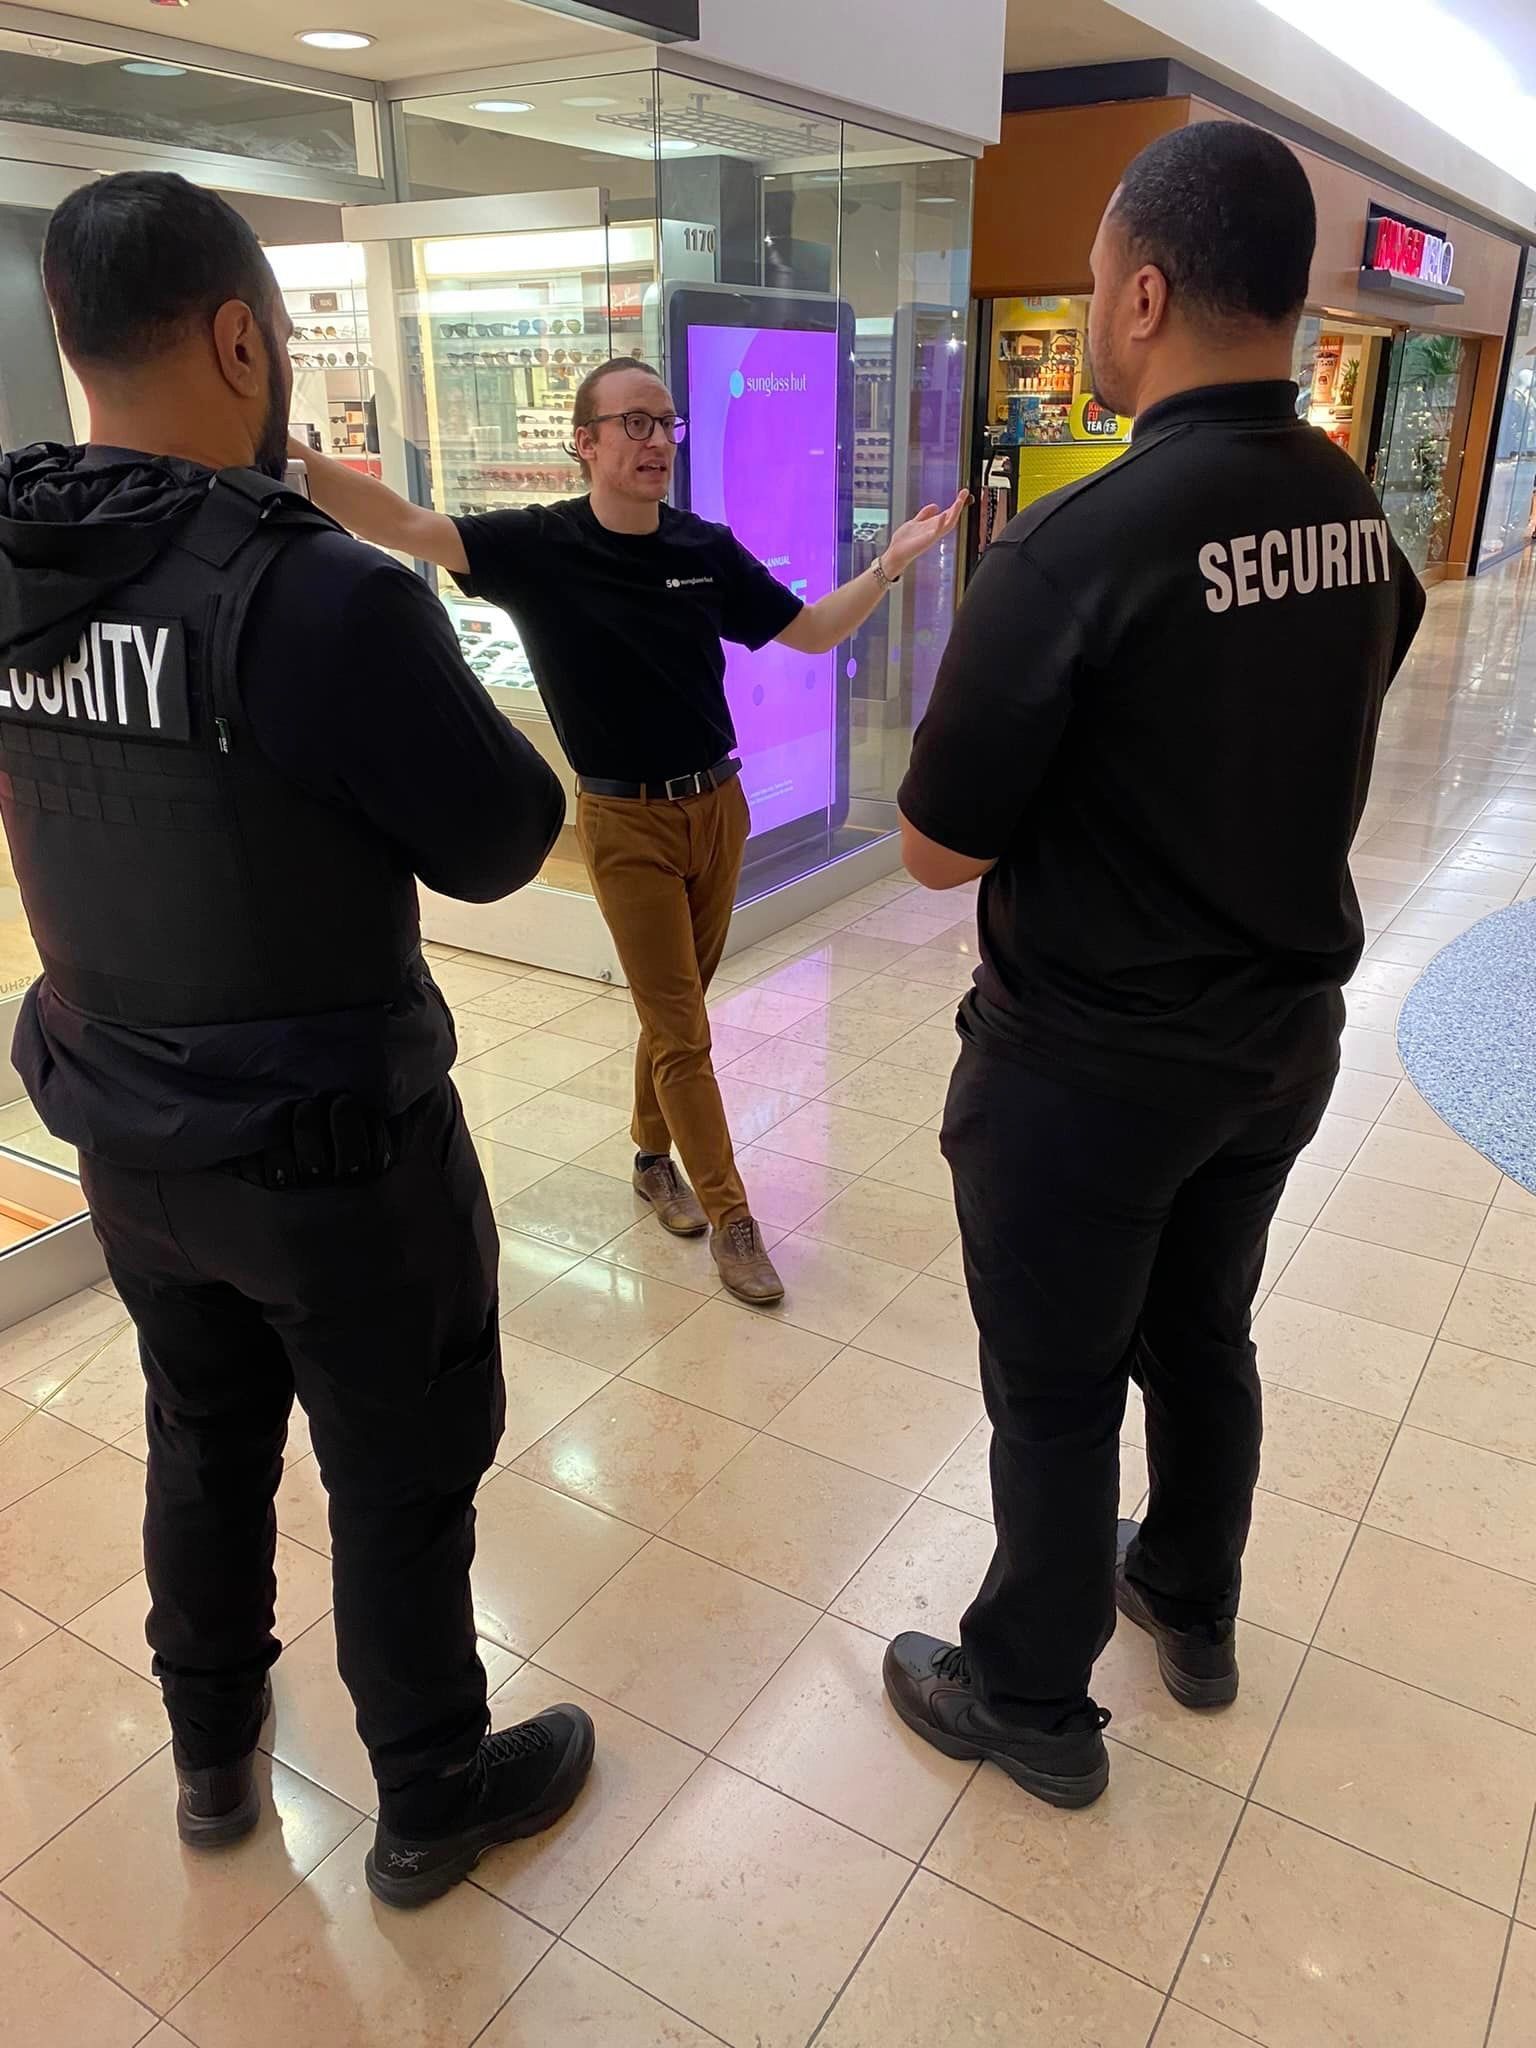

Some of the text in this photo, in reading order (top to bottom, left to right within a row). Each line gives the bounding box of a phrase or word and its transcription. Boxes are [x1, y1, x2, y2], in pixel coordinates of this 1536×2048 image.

[684, 227, 716, 253] 1170
[746, 371, 807, 397] sunglass hut
[1087, 421, 1102, 432] TEA
[1088, 411, 1098, 422] FU
[1199, 519, 1390, 613] SECURITY
